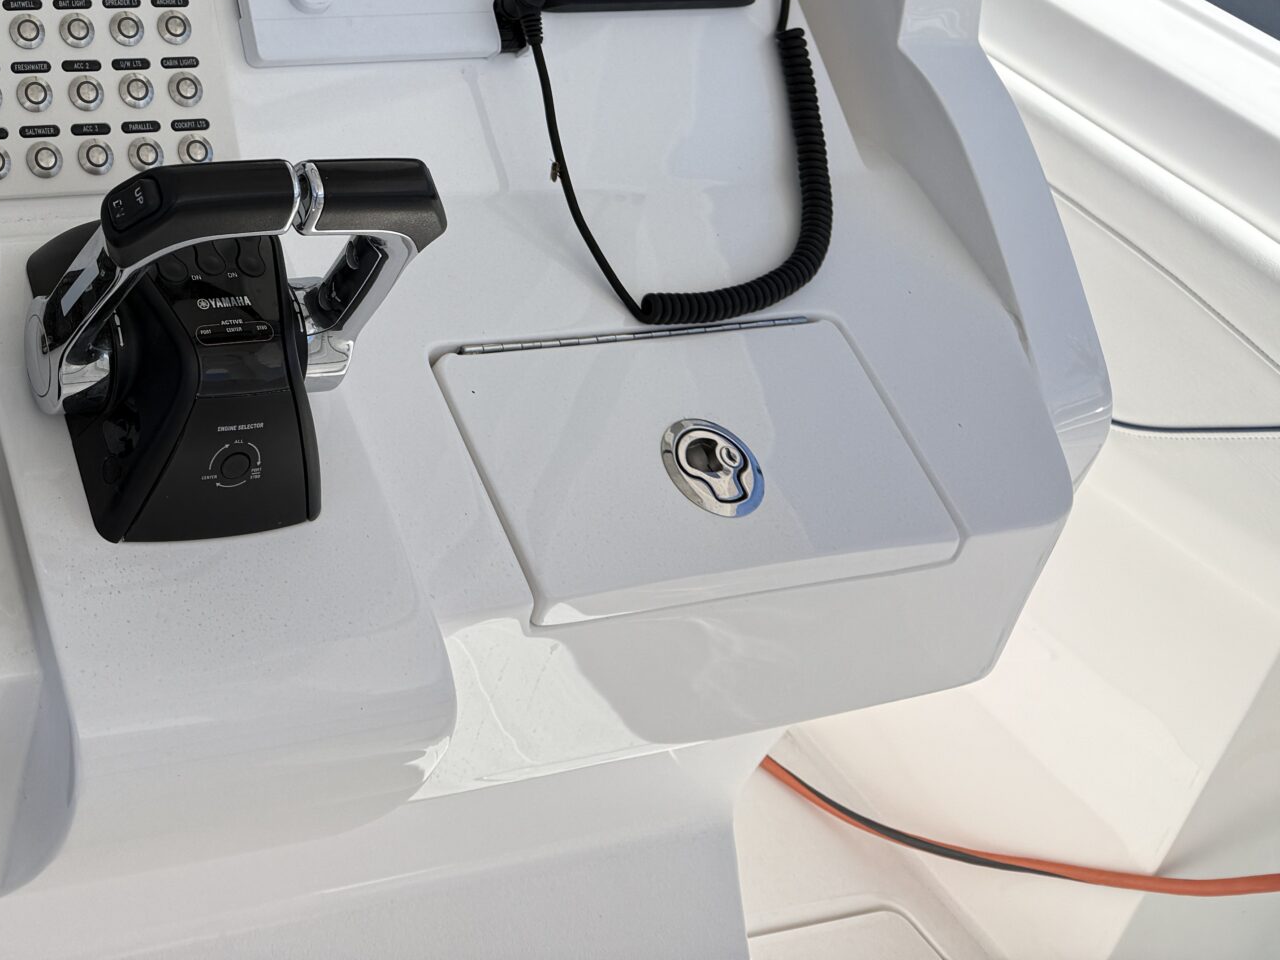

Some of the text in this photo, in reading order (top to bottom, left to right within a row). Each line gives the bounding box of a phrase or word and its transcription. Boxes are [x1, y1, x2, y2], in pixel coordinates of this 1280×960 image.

[180, 58, 197, 66] LIGHTS
[14, 63, 48, 71] FRESHWATER
[128, 123, 154, 131] PARALLEL
[174, 120, 206, 129] COCKPIT LTS
[133, 187, 144, 205] UP
[208, 295, 252, 309] YAMAHA
[238, 422, 264, 431] SELECTOR
